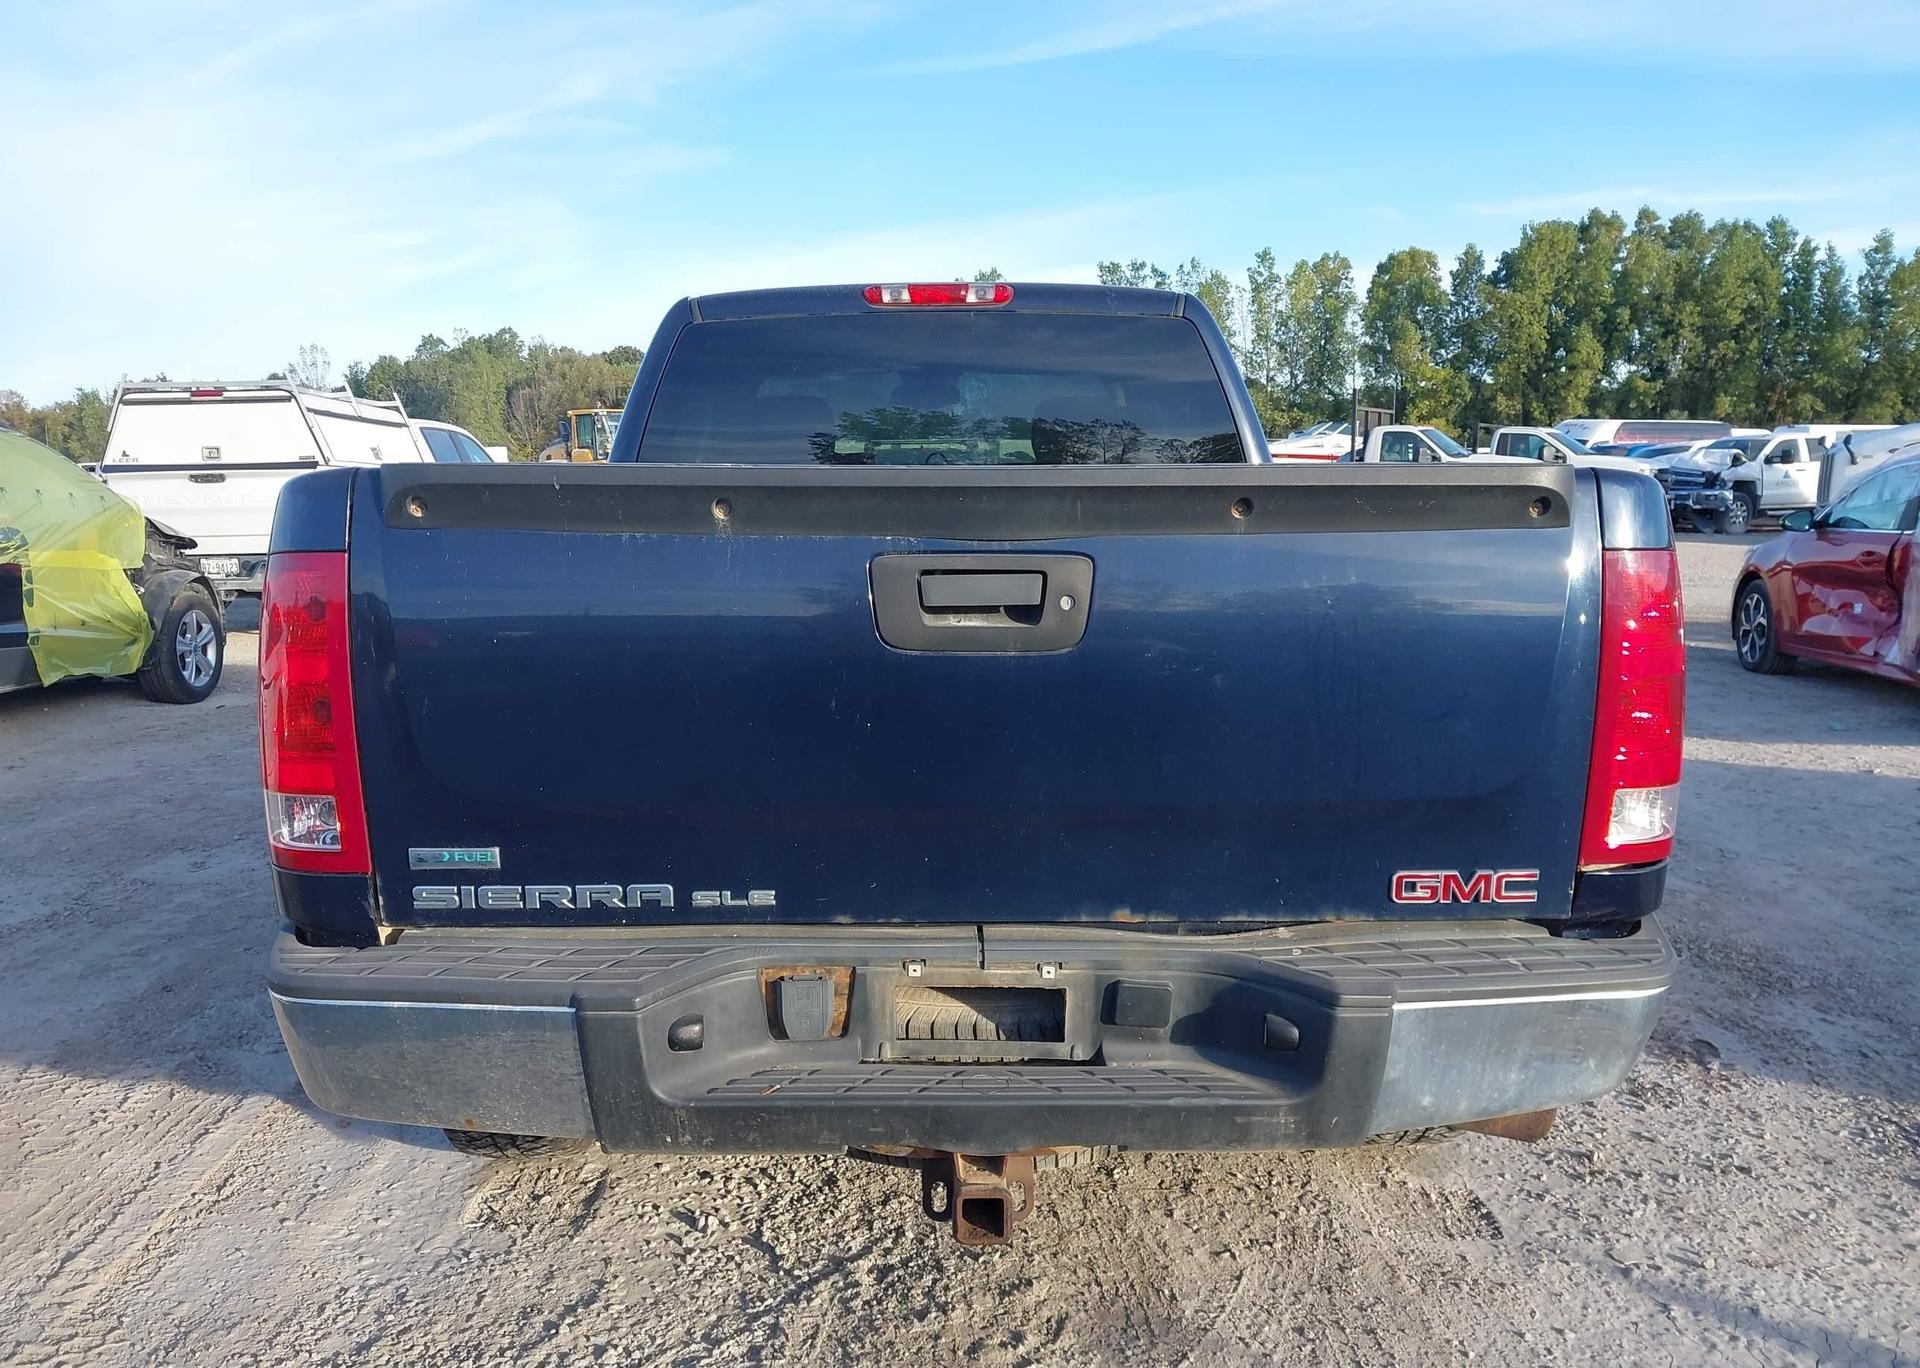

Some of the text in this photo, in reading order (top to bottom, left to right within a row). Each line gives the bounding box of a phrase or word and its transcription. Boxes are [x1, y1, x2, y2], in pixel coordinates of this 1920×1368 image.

[412, 884, 776, 909] SIERRA SLE
[1392, 869, 1540, 903] GMC
